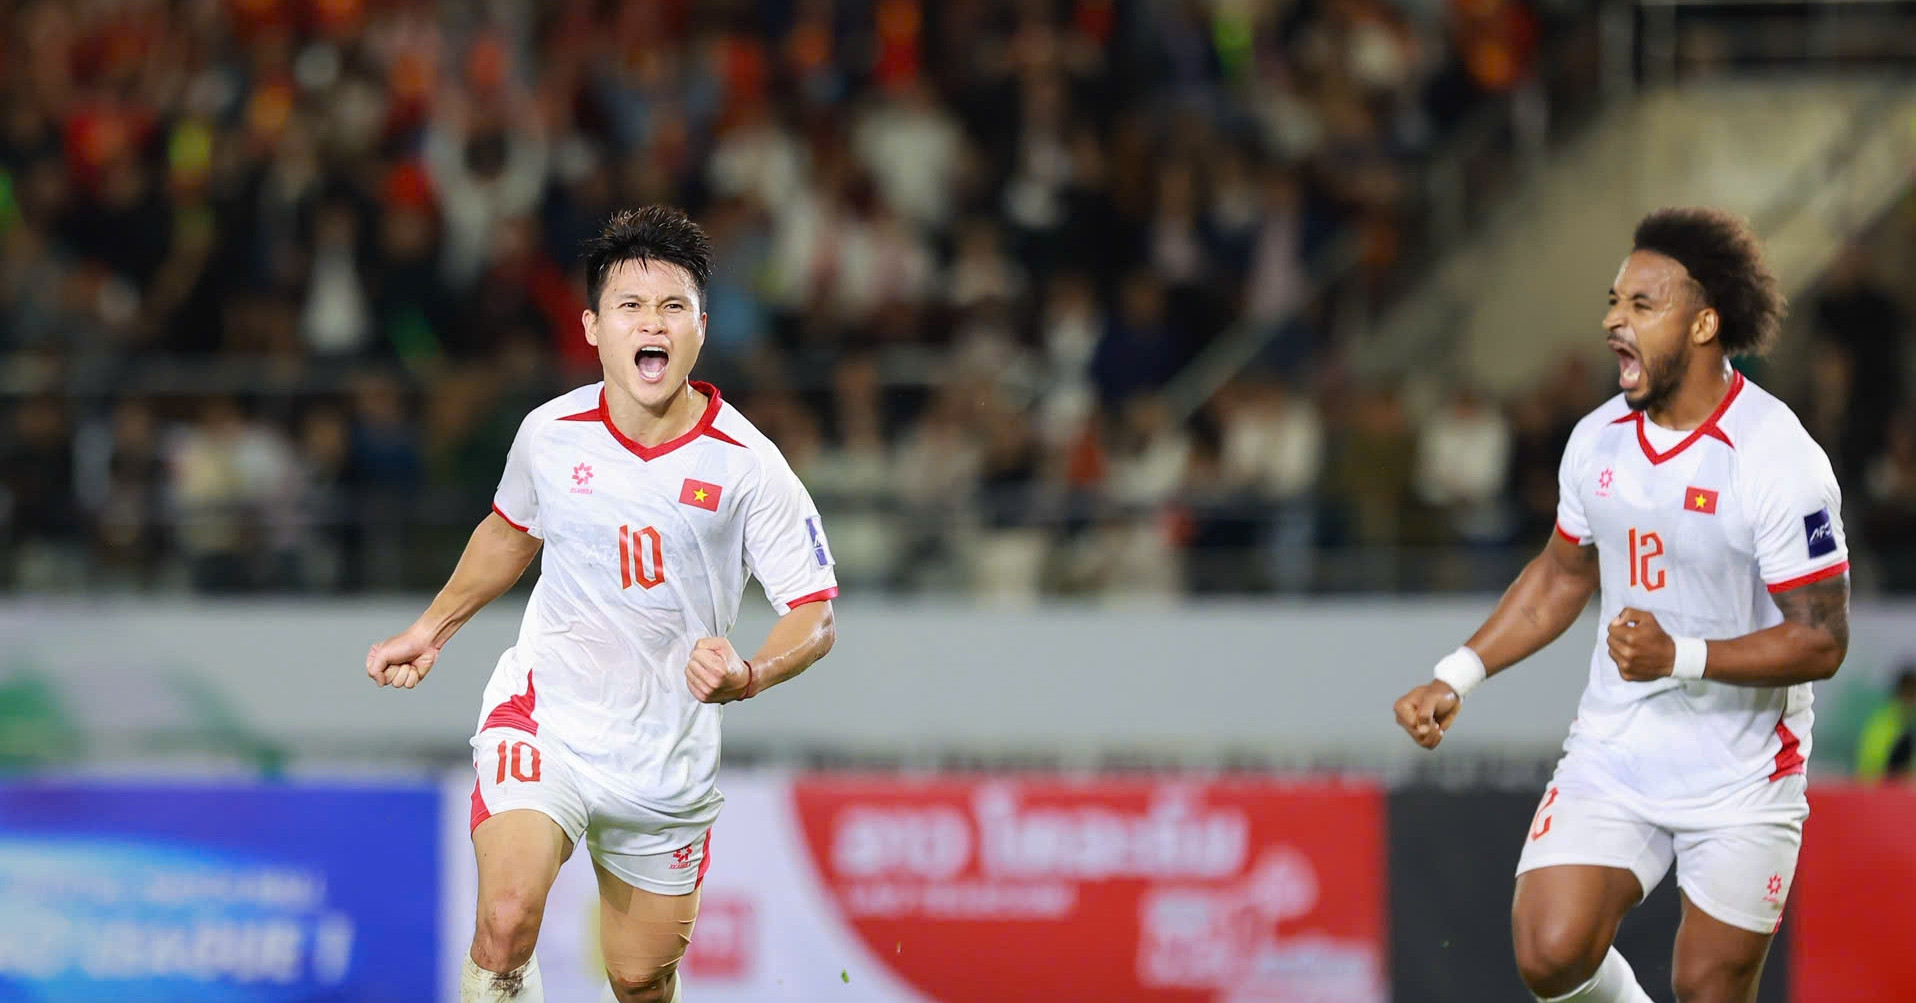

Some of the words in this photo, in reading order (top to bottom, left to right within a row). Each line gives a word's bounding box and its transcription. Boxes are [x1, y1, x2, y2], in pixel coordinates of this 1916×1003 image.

[619, 524, 665, 590] 10
[1629, 527, 1665, 591] 12
[496, 739, 541, 785] 10
